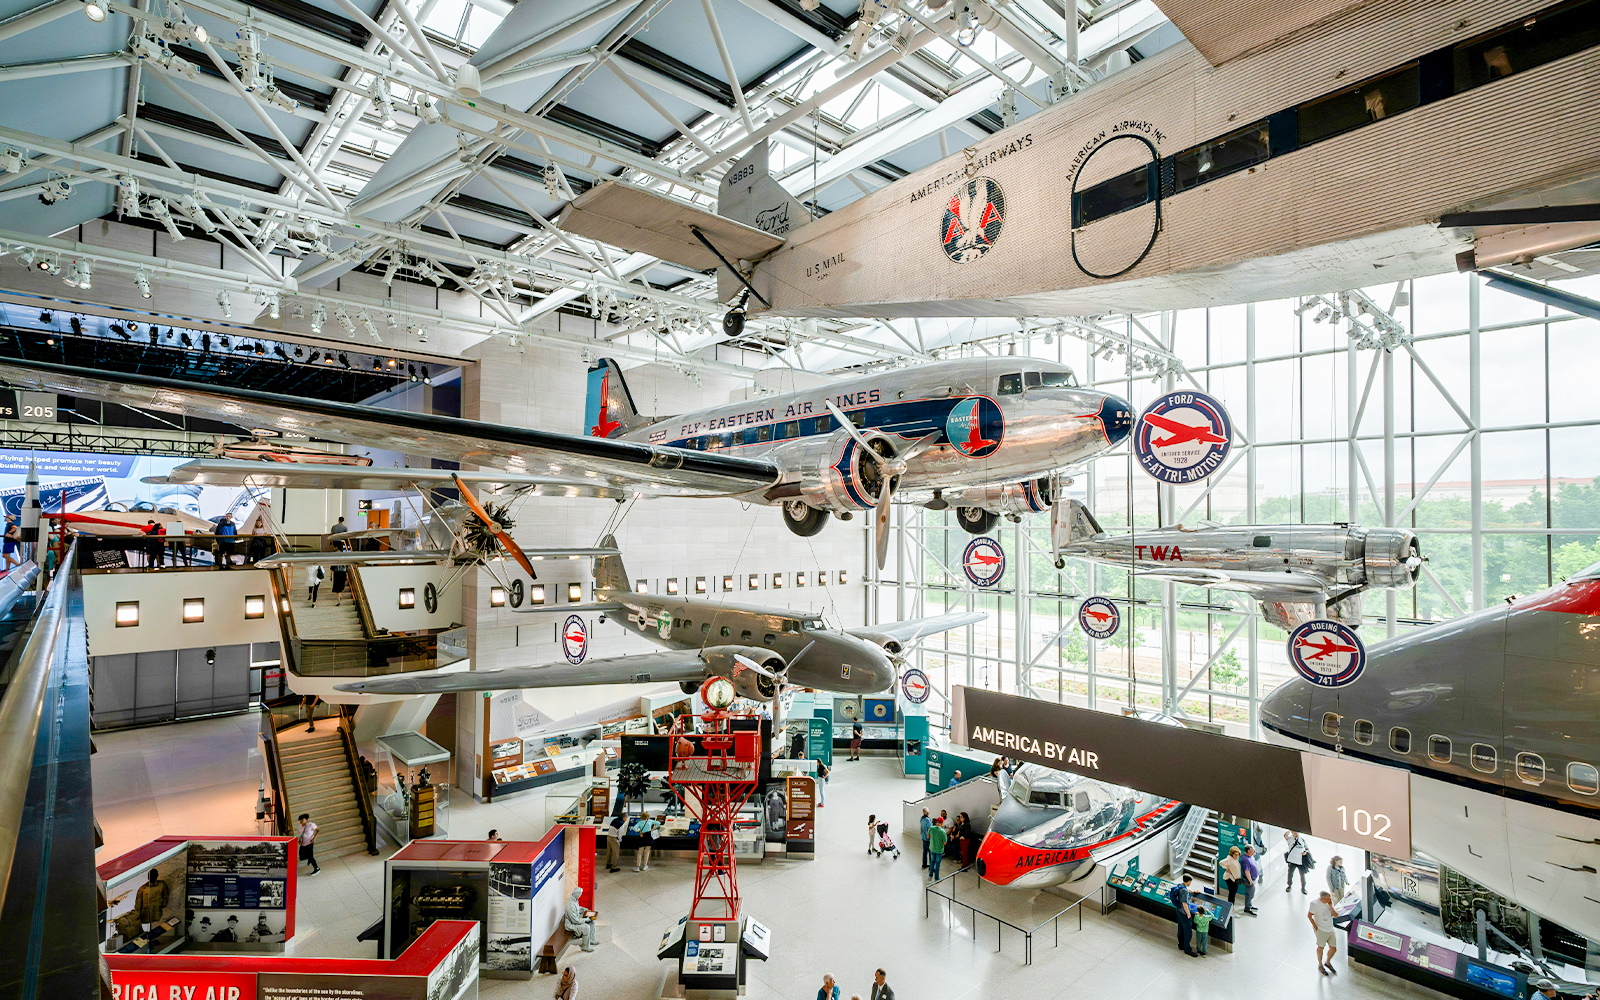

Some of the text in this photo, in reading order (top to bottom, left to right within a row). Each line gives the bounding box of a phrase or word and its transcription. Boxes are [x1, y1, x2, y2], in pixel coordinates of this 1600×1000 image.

[976, 133, 1033, 169] AIRWAYS
[1065, 120, 1167, 181] AMERICAN AIRWAYS INC
[728, 164, 754, 187] N9683
[756, 201, 789, 231] Ford
[823, 253, 845, 269] MAIL
[1168, 394, 1194, 406] FORD
[24, 405, 54, 418] 205
[709, 408, 775, 431] EASTERN
[785, 400, 813, 418] AIR
[951, 415, 978, 424] EASTERN
[0, 455, 23, 463] Flying
[98, 459, 121, 467] beauty
[1143, 451, 1223, 482] 5-AT TRI-MOTOR
[1135, 545, 1183, 561] TWA
[1311, 622, 1338, 632] BOEING
[1318, 675, 1333, 685] 747
[972, 725, 1099, 770] AMERICA BY AIR
[1336, 804, 1392, 843] 102
[1015, 849, 1078, 868] AMERICAN
[170, 985, 196, 1000] BY
[205, 986, 240, 1000] AIR
